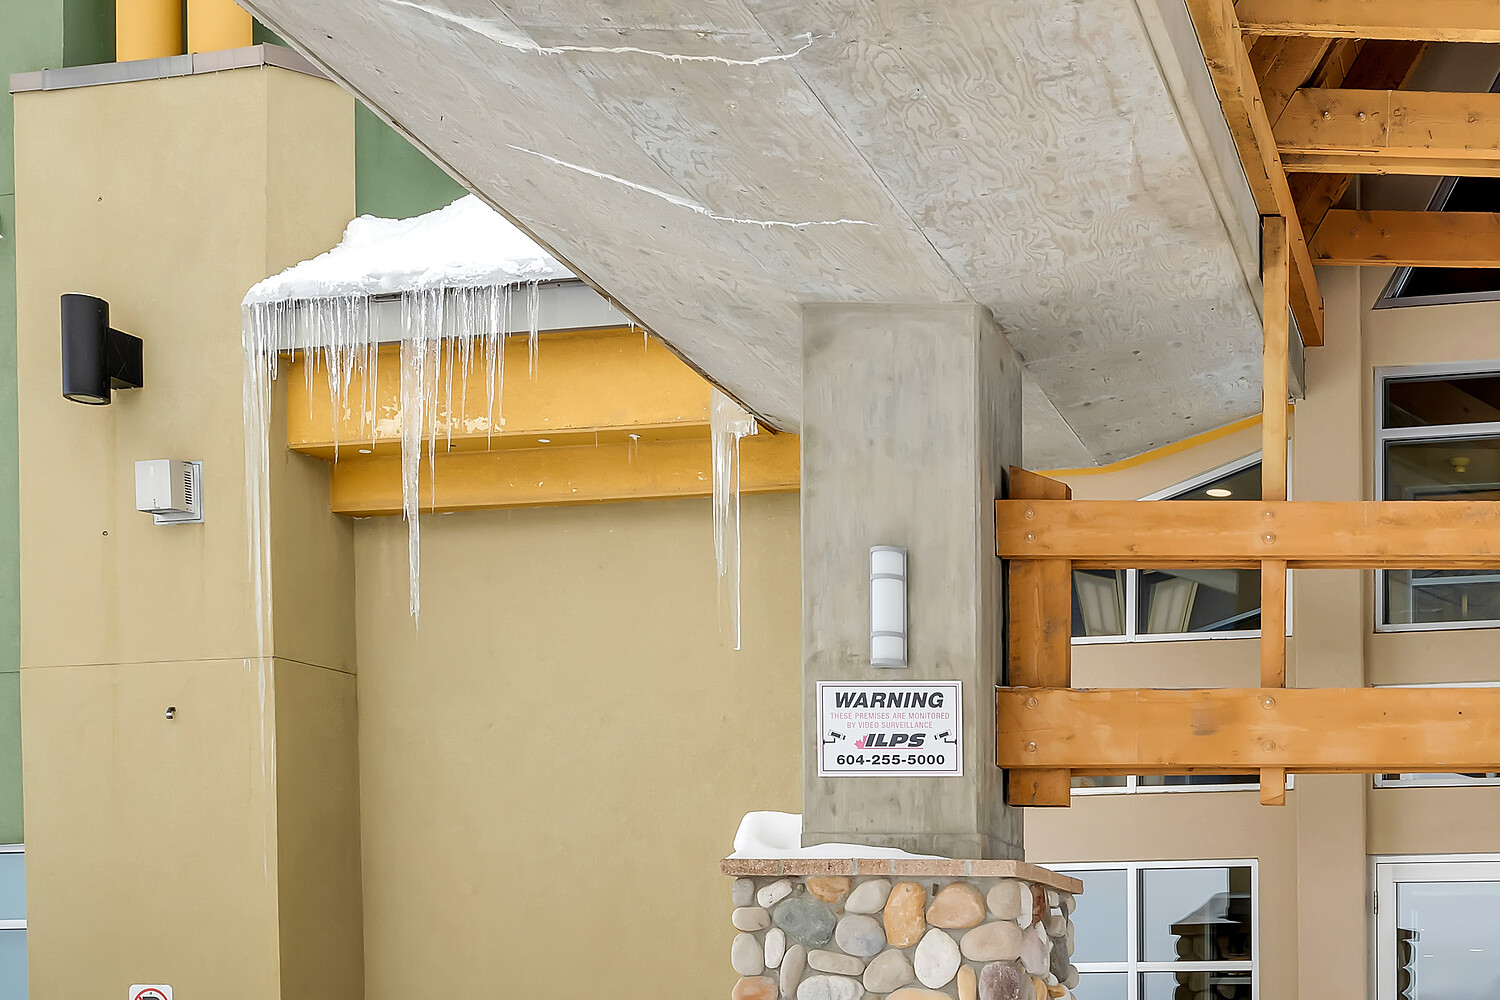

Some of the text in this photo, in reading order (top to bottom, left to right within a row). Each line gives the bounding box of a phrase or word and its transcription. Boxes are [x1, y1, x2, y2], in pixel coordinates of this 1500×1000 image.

[835, 692, 944, 708] WARNING
[865, 733, 926, 747] ILPS
[836, 754, 945, 765] 604-255-5000
